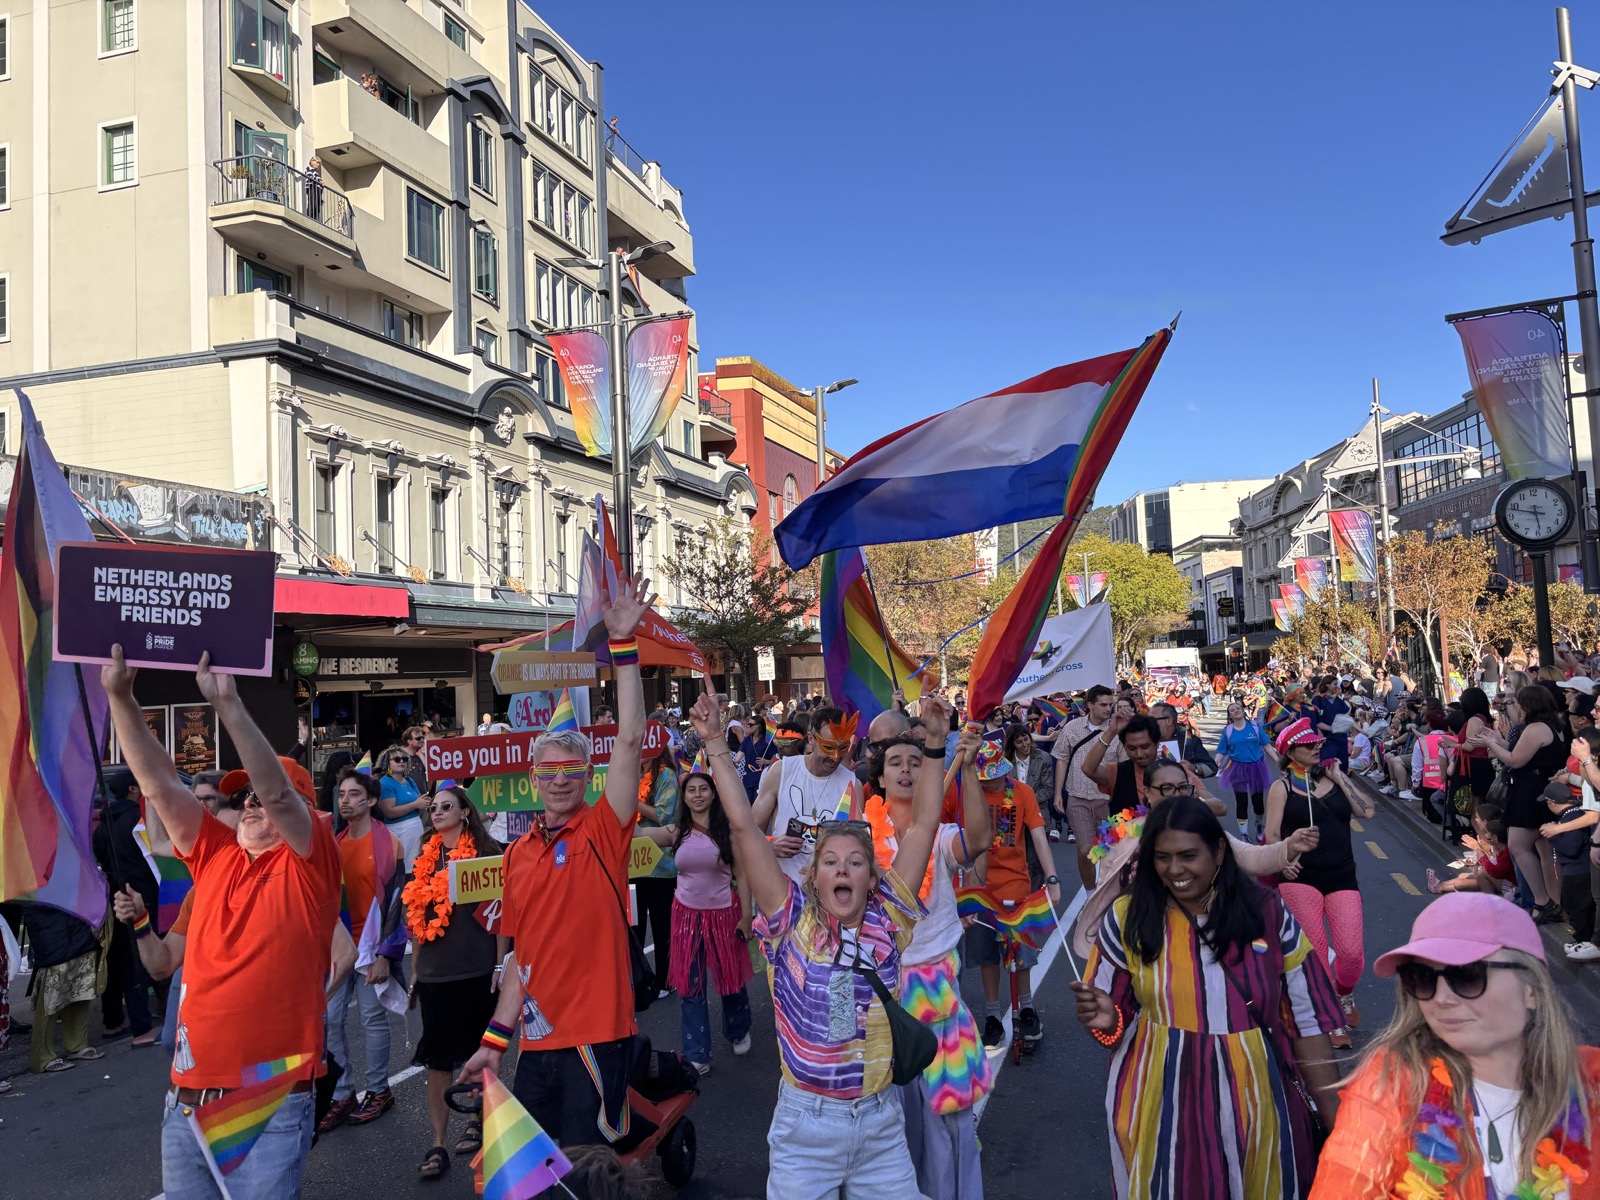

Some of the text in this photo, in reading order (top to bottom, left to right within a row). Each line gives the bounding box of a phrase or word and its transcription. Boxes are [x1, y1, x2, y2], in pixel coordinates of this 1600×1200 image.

[1547, 305, 1558, 314] W
[560, 348, 570, 356] 40
[1530, 488, 1538, 496] 12
[1459, 496, 1480, 510] THEATRE
[1510, 502, 1519, 510] 10
[1552, 498, 1558, 506] 2
[1557, 508, 1562, 516] 3
[94, 567, 232, 591] NETHERLANDS
[94, 586, 230, 610] EMBASSY AND
[121, 606, 202, 626] FRIENDS
[340, 658, 398, 674] RESIDENCE
[522, 663, 528, 681] IS
[530, 663, 550, 680] ALWAYS
[550, 663, 562, 680] PART
[562, 663, 568, 680] OF
[569, 663, 578, 679] THE
[430, 745, 462, 771] See
[470, 748, 500, 774] you
[506, 739, 522, 764] in
[482, 779, 503, 805] WE
